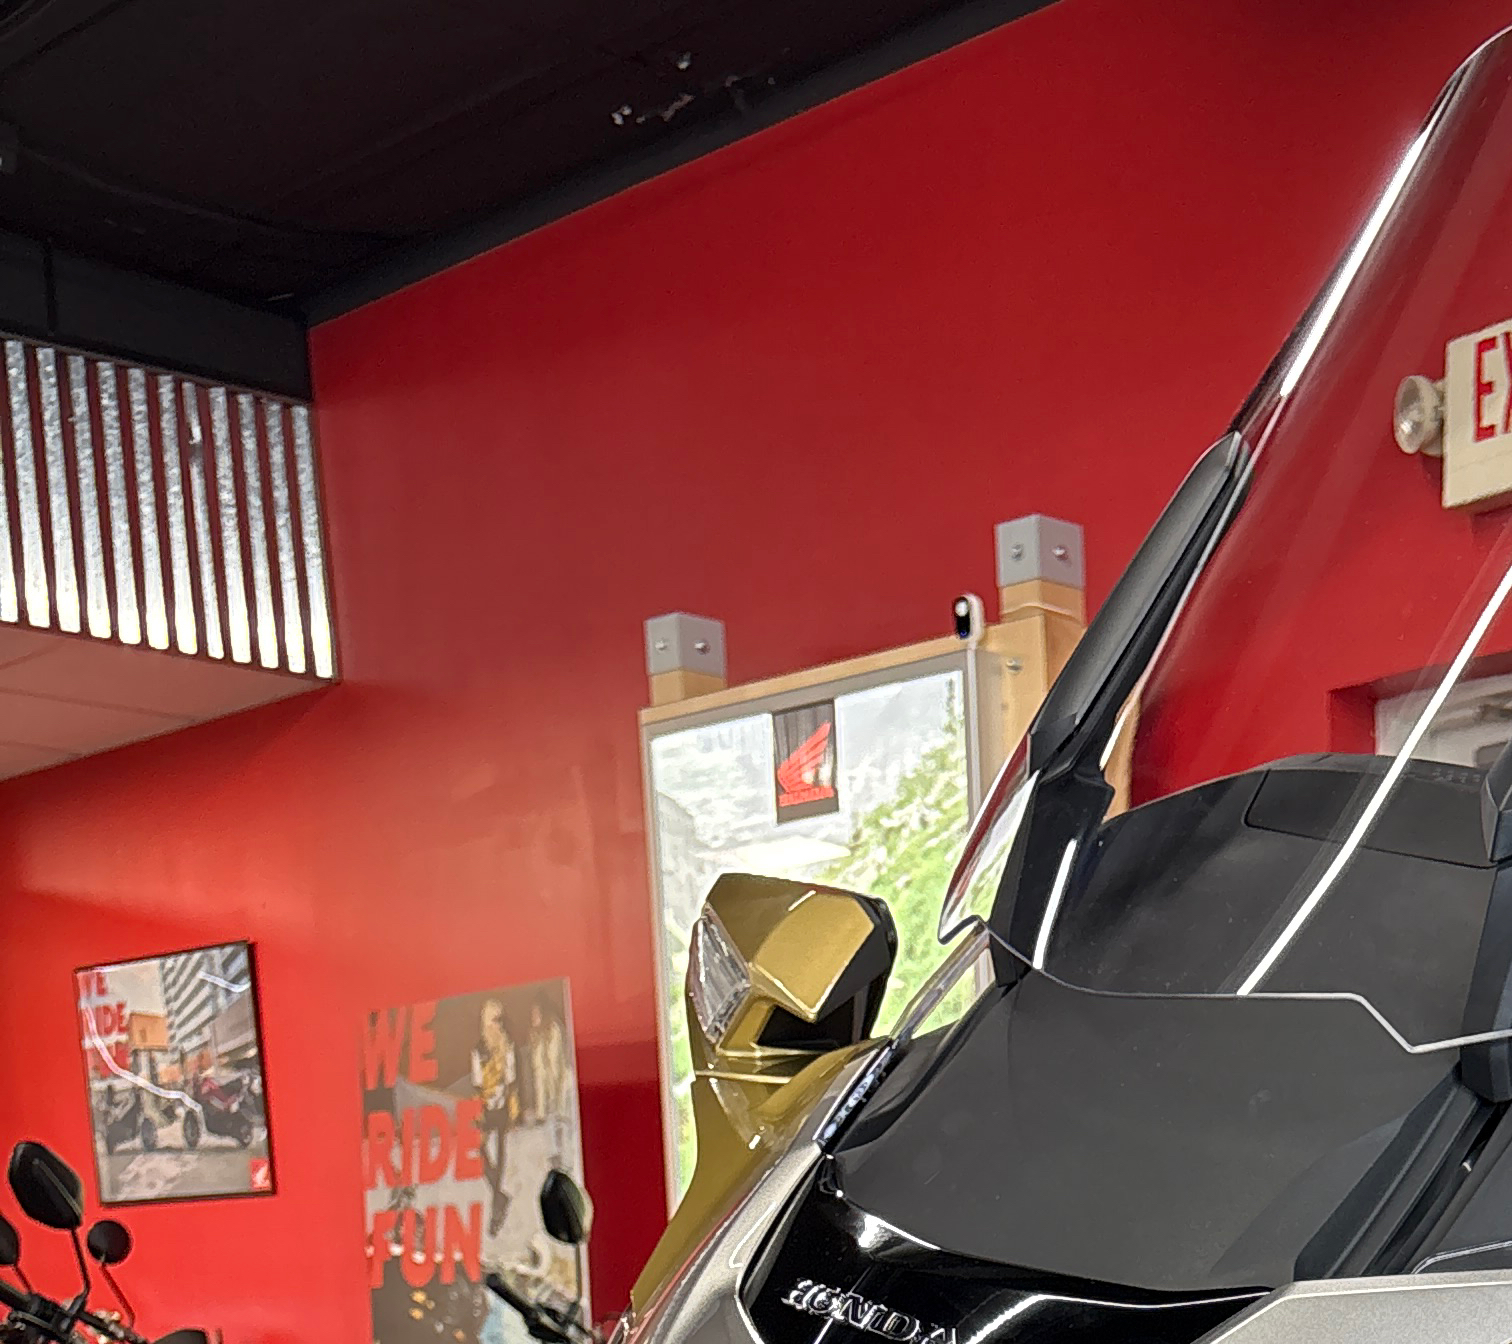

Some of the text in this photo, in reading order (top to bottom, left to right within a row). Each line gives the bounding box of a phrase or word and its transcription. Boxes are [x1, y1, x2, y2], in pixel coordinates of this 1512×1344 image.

[361, 1001, 439, 1091] WE
[365, 1098, 484, 1190] RIDE
[370, 1202, 484, 1290] FUN
